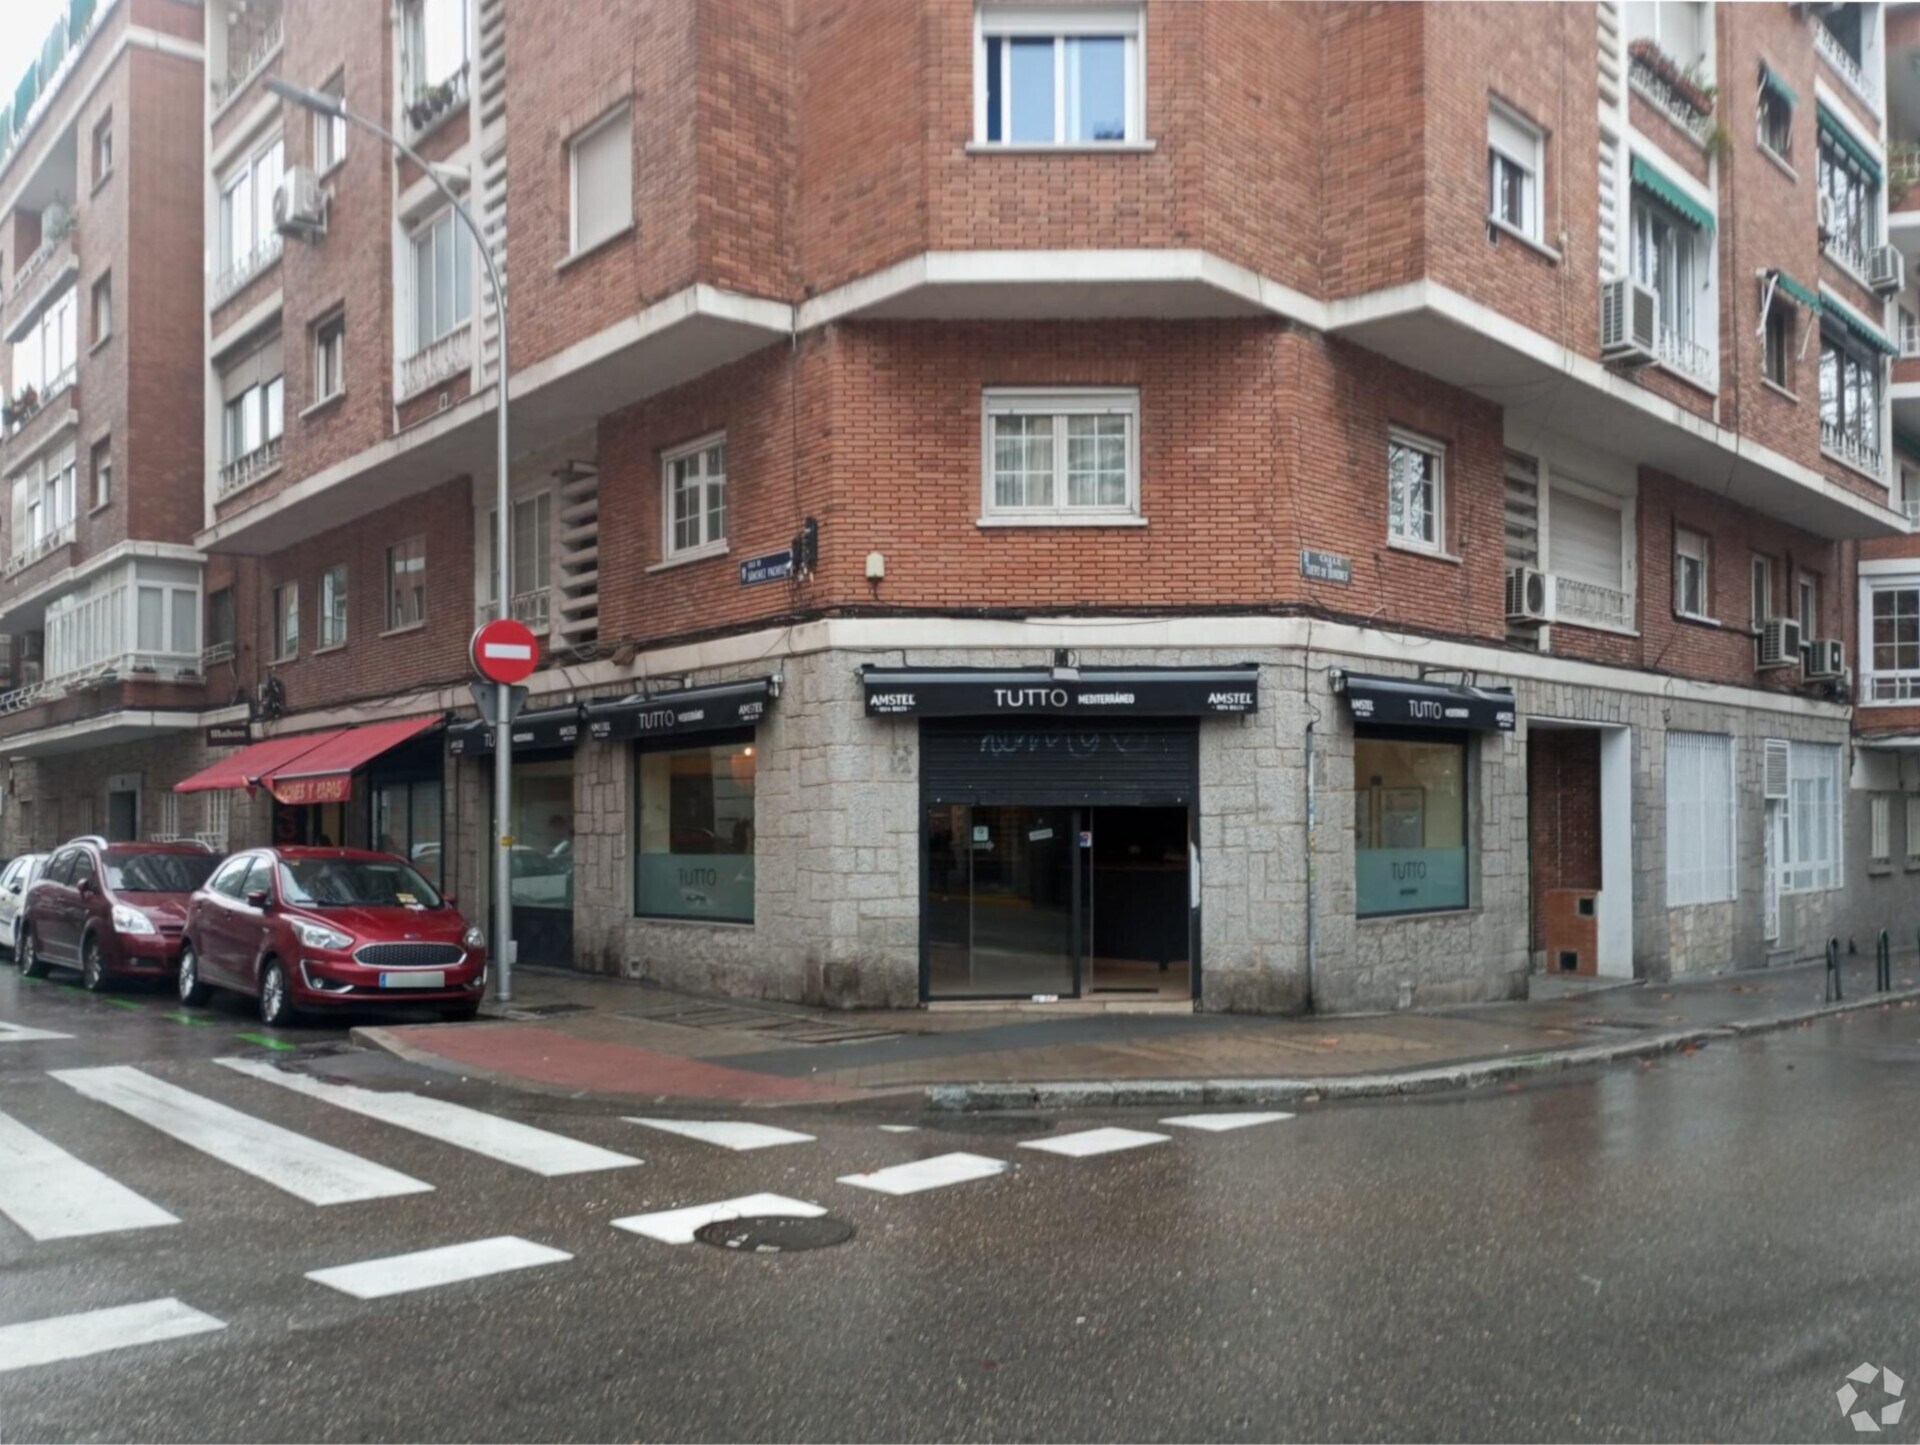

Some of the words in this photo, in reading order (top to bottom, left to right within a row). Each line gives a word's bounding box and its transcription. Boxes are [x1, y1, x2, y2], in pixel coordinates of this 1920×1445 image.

[870, 693, 916, 706] AMSTEL
[994, 688, 1068, 707] TUTTO
[1207, 692, 1253, 704] AMSTEL
[738, 702, 763, 715] AMSTEL
[1409, 700, 1442, 719] TUTTO
[638, 710, 675, 729] TUTTO
[677, 868, 717, 887] TUTTO
[1392, 861, 1427, 880] TUTTO
